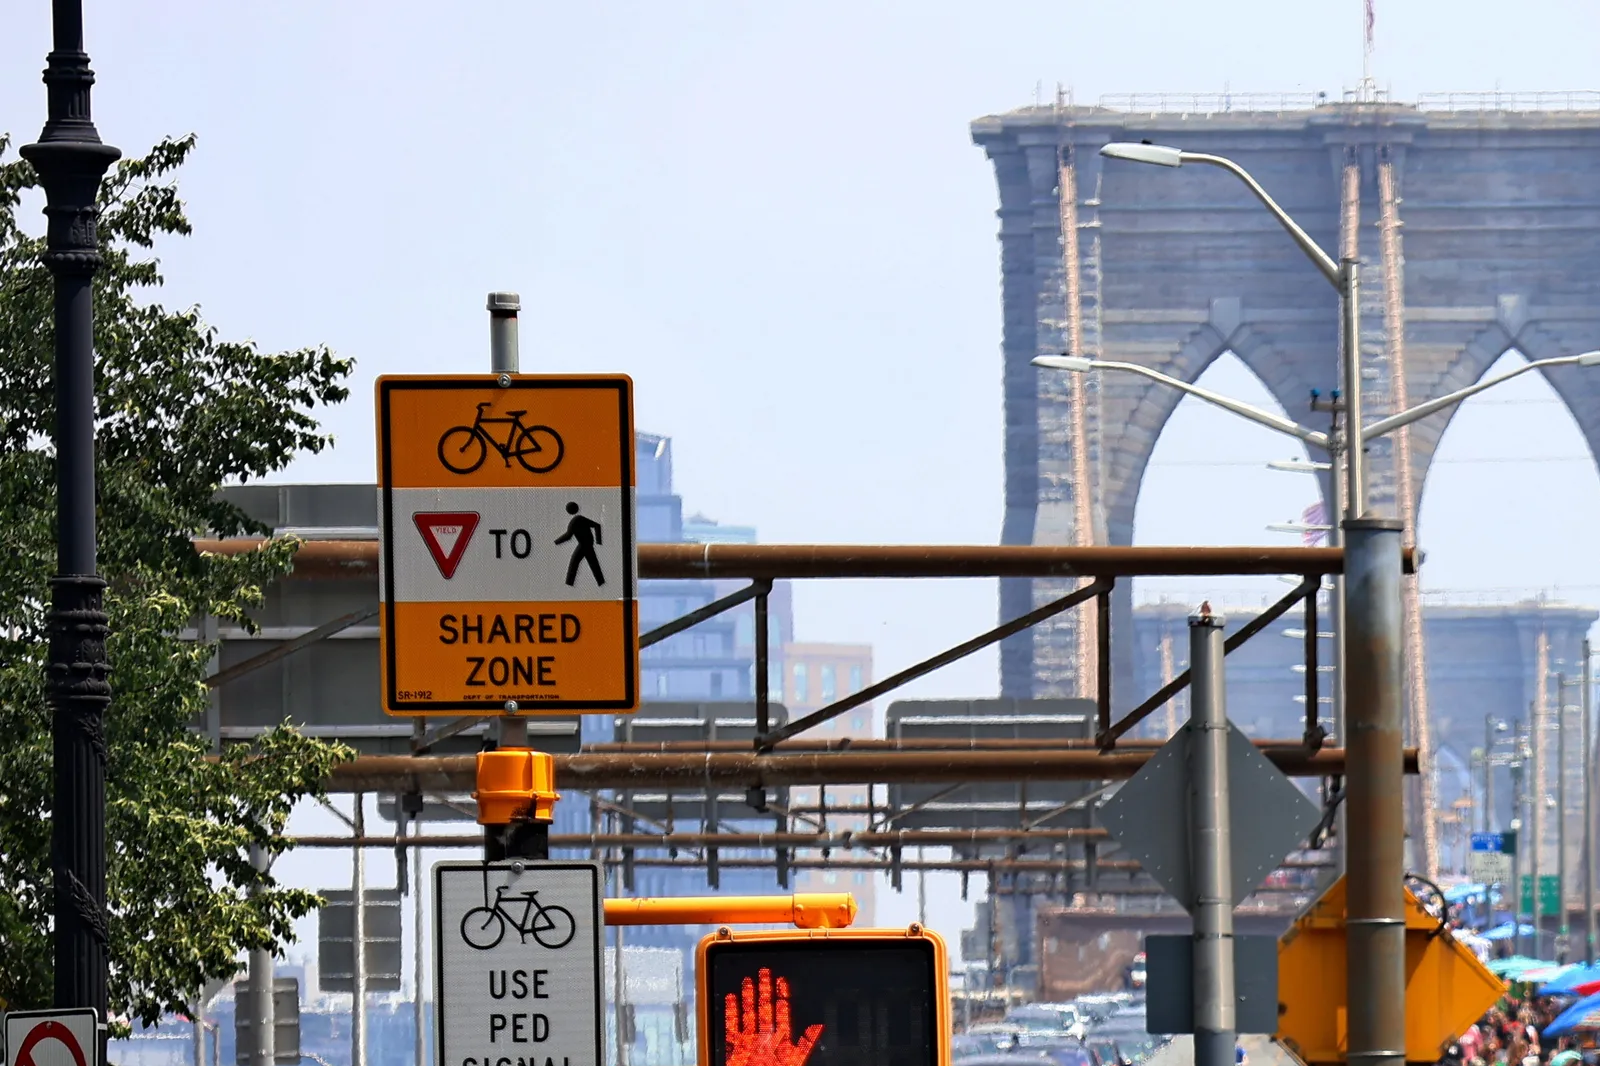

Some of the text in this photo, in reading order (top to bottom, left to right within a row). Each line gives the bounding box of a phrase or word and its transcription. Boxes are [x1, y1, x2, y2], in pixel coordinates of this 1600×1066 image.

[435, 526, 457, 534] YIELD
[489, 529, 532, 559] TO
[439, 613, 581, 644] SHARED
[465, 656, 556, 686] ZONE
[398, 691, 432, 700] SR-1912
[489, 969, 549, 999] USE
[490, 1013, 549, 1043] PED
